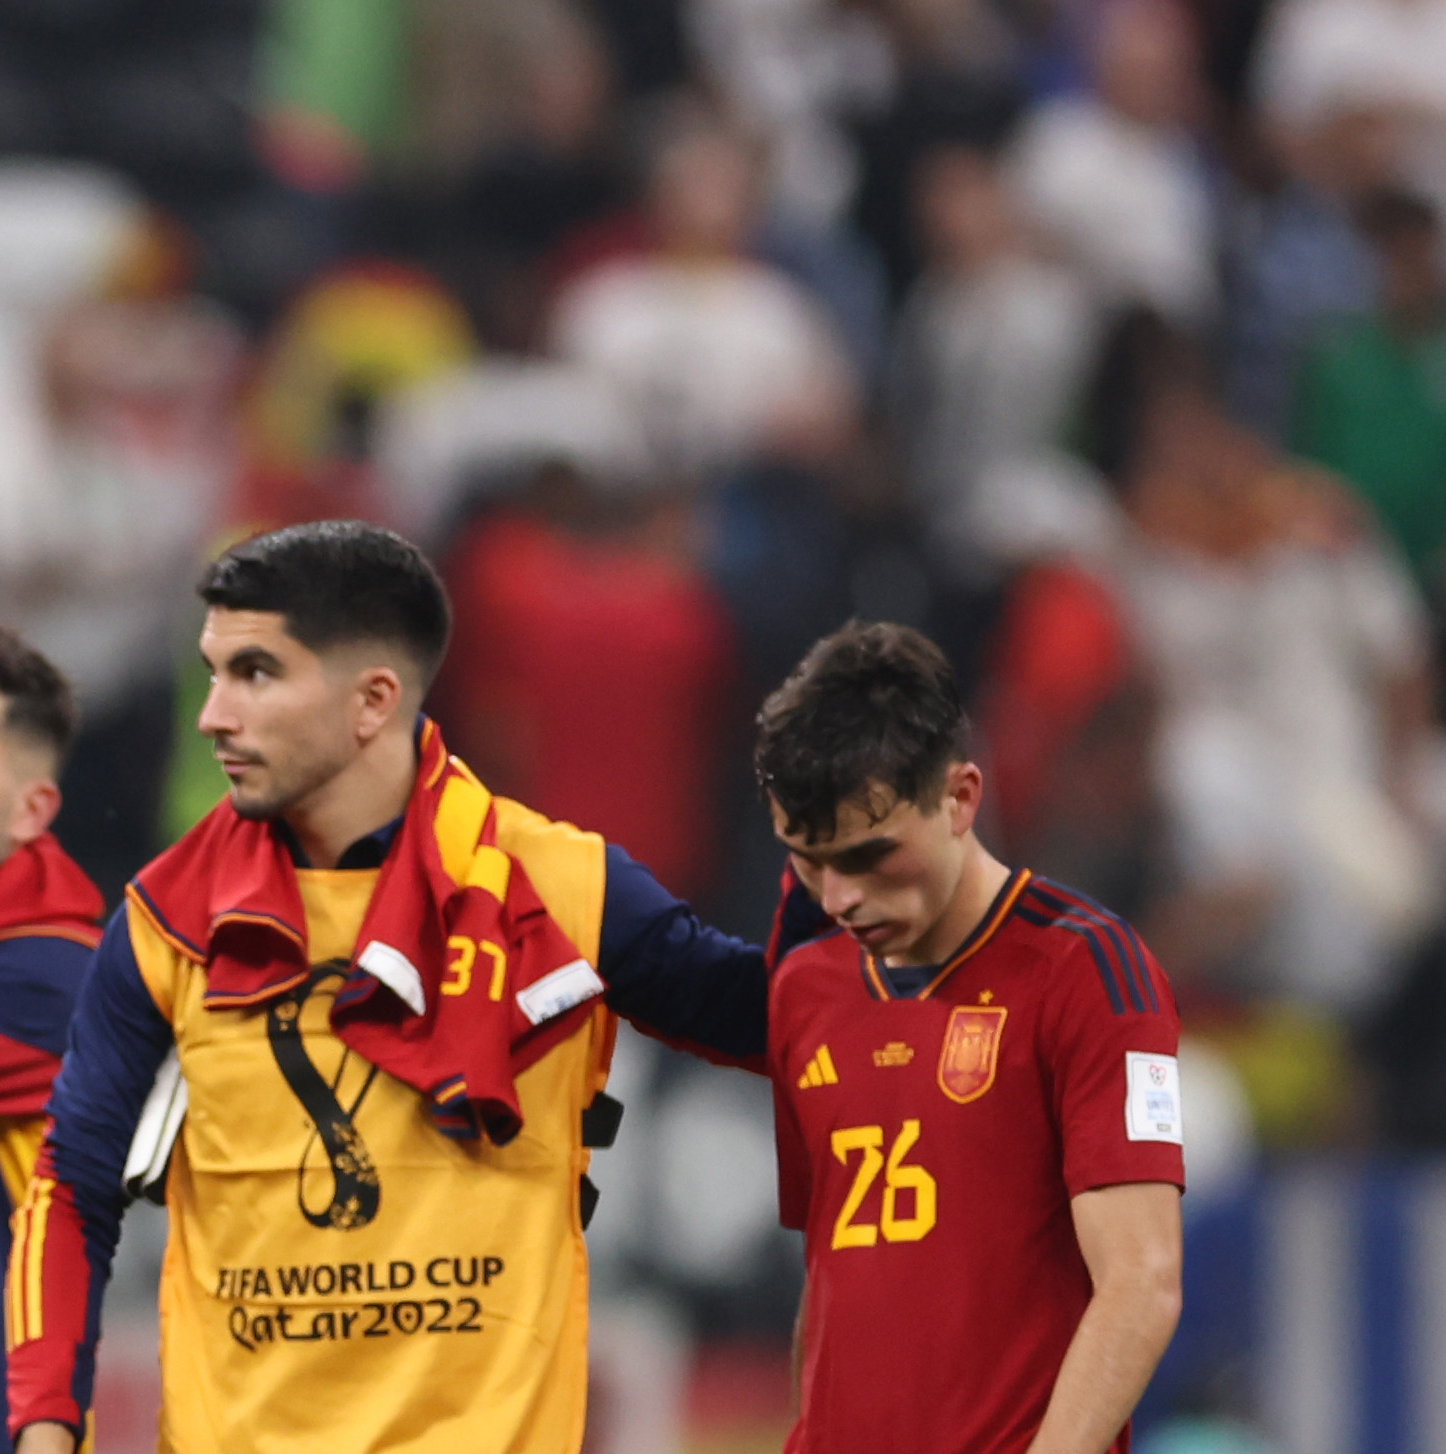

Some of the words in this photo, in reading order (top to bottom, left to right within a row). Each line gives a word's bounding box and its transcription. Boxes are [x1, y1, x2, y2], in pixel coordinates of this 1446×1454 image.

[830, 1118, 937, 1250] 26
[216, 1266, 272, 1298] FIFA
[277, 1261, 415, 1297] WORLD
[426, 1256, 504, 1288] CUP
